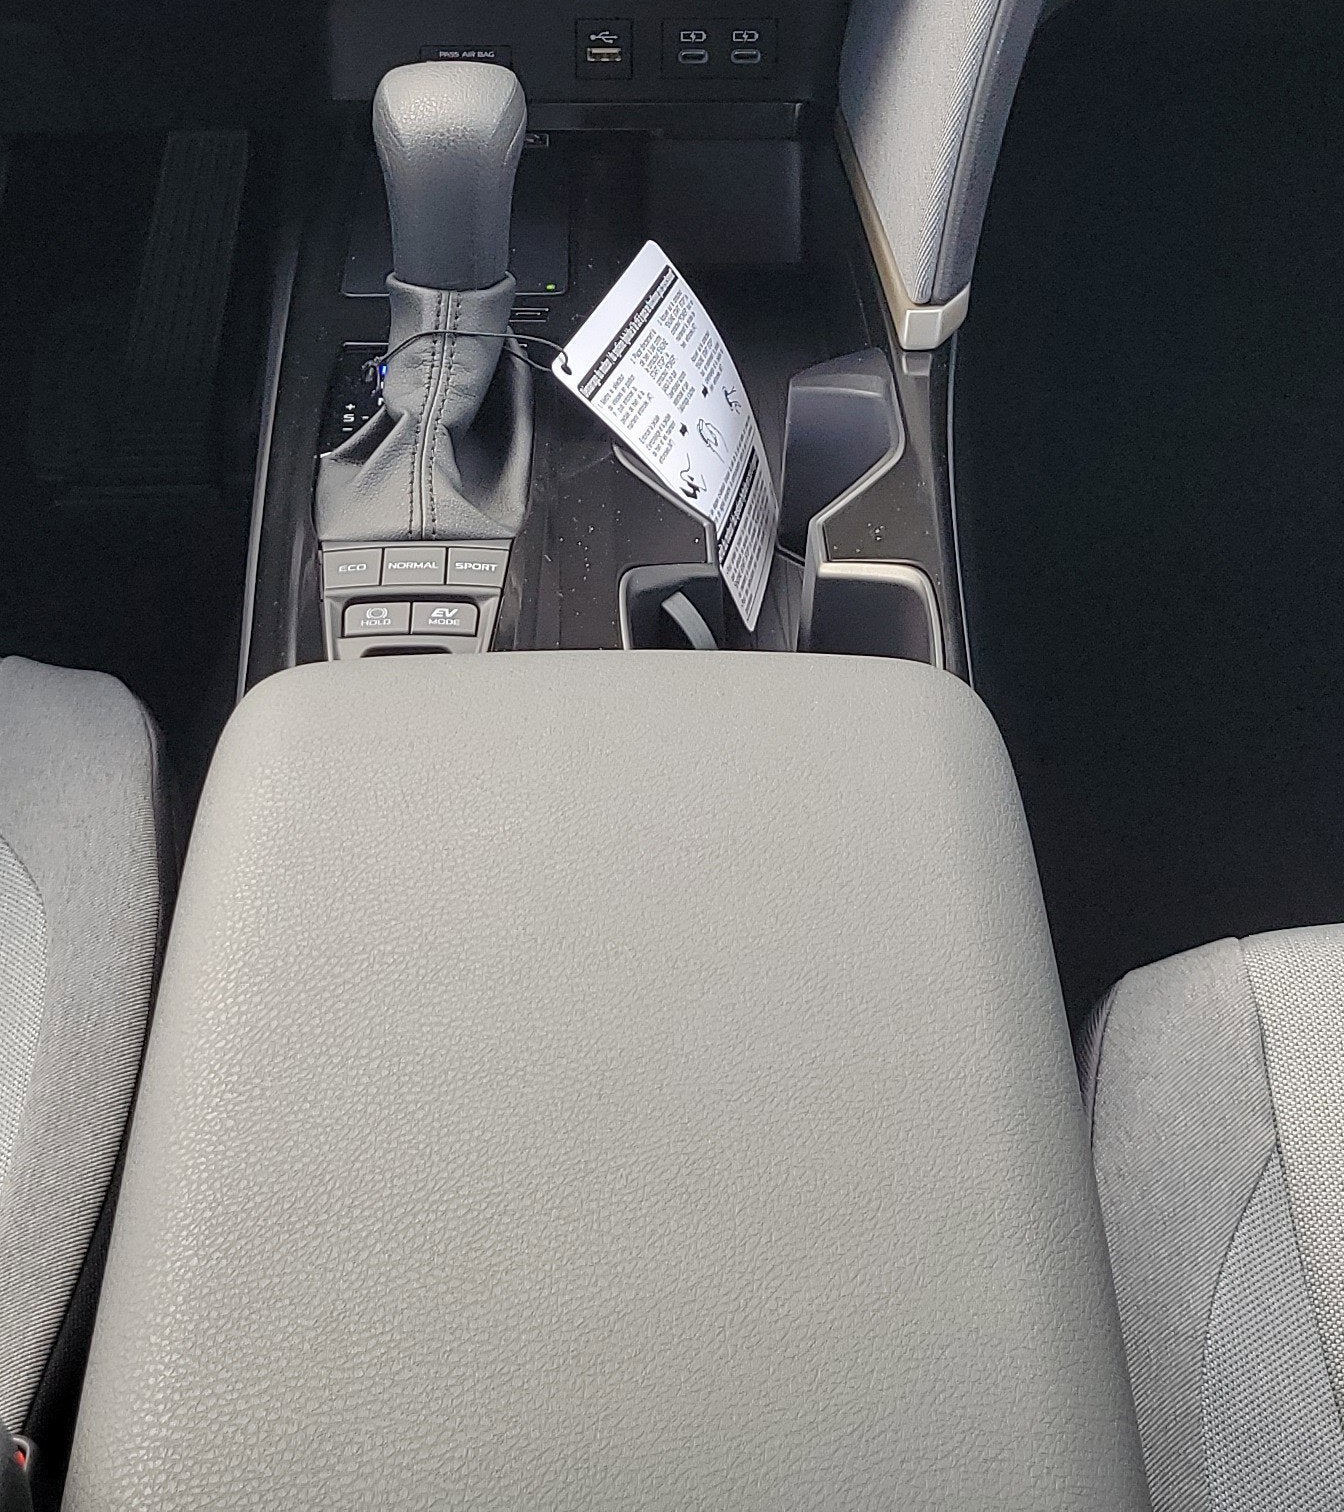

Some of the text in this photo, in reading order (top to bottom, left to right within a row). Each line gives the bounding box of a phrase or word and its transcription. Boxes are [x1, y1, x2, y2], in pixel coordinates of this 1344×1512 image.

[343, 414, 355, 423] S
[338, 563, 367, 573] ECO
[388, 560, 439, 571] NORMAL
[455, 562, 498, 573] SPORT
[431, 608, 457, 618] EV
[361, 618, 391, 627] HOLD
[429, 618, 460, 626] MODE
